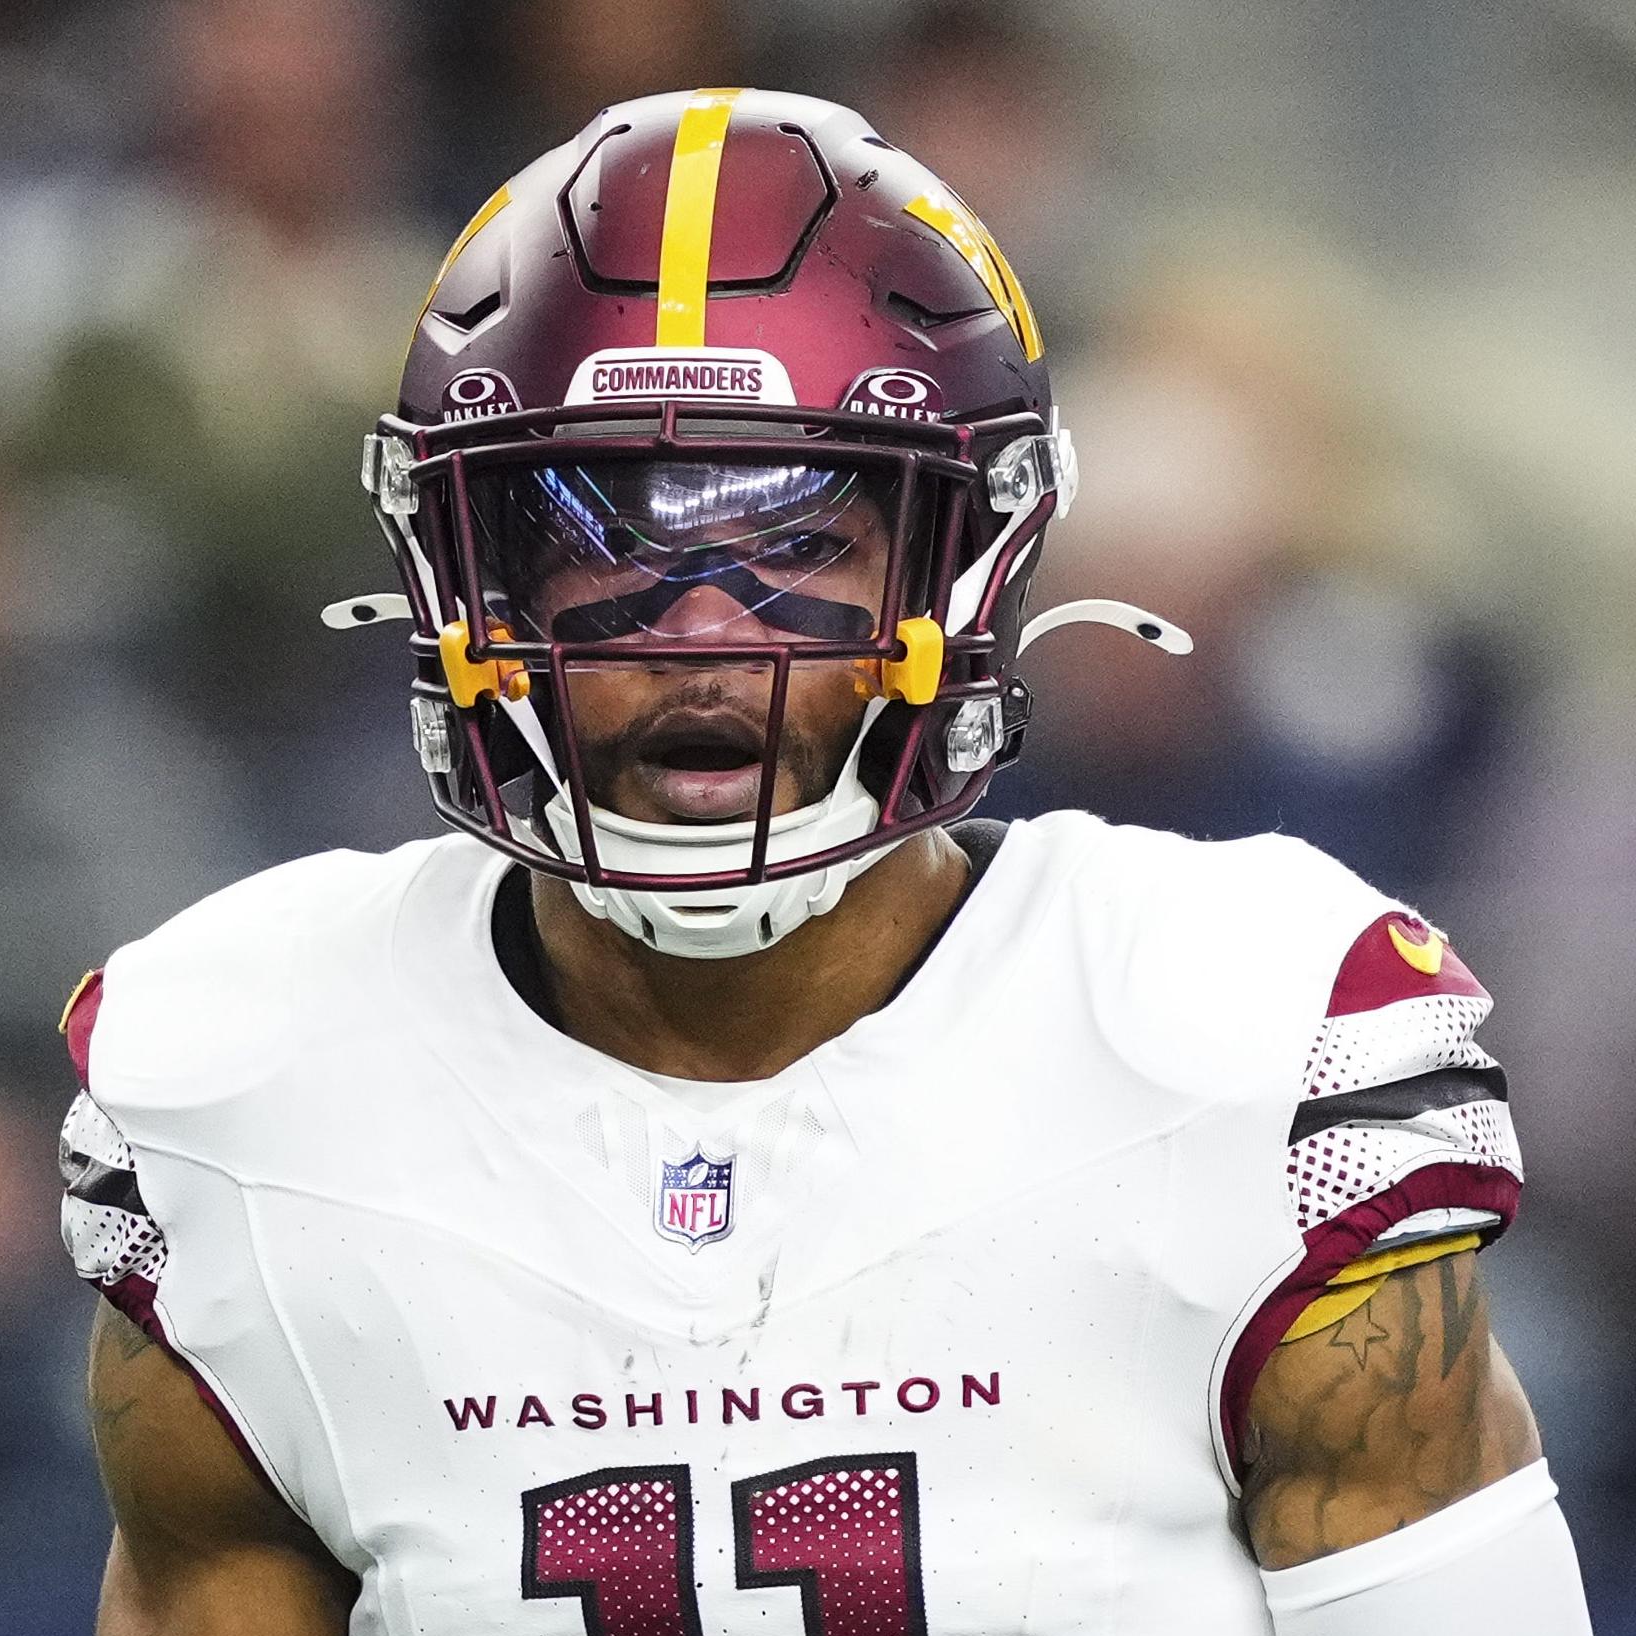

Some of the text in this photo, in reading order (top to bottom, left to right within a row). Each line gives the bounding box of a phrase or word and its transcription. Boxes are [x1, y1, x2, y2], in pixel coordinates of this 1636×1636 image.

[593, 366, 762, 393] COMMANDERS
[444, 402, 509, 423] OAKLEY
[667, 1192, 722, 1232] NFL
[444, 1372, 1001, 1431] WASHINGTON
